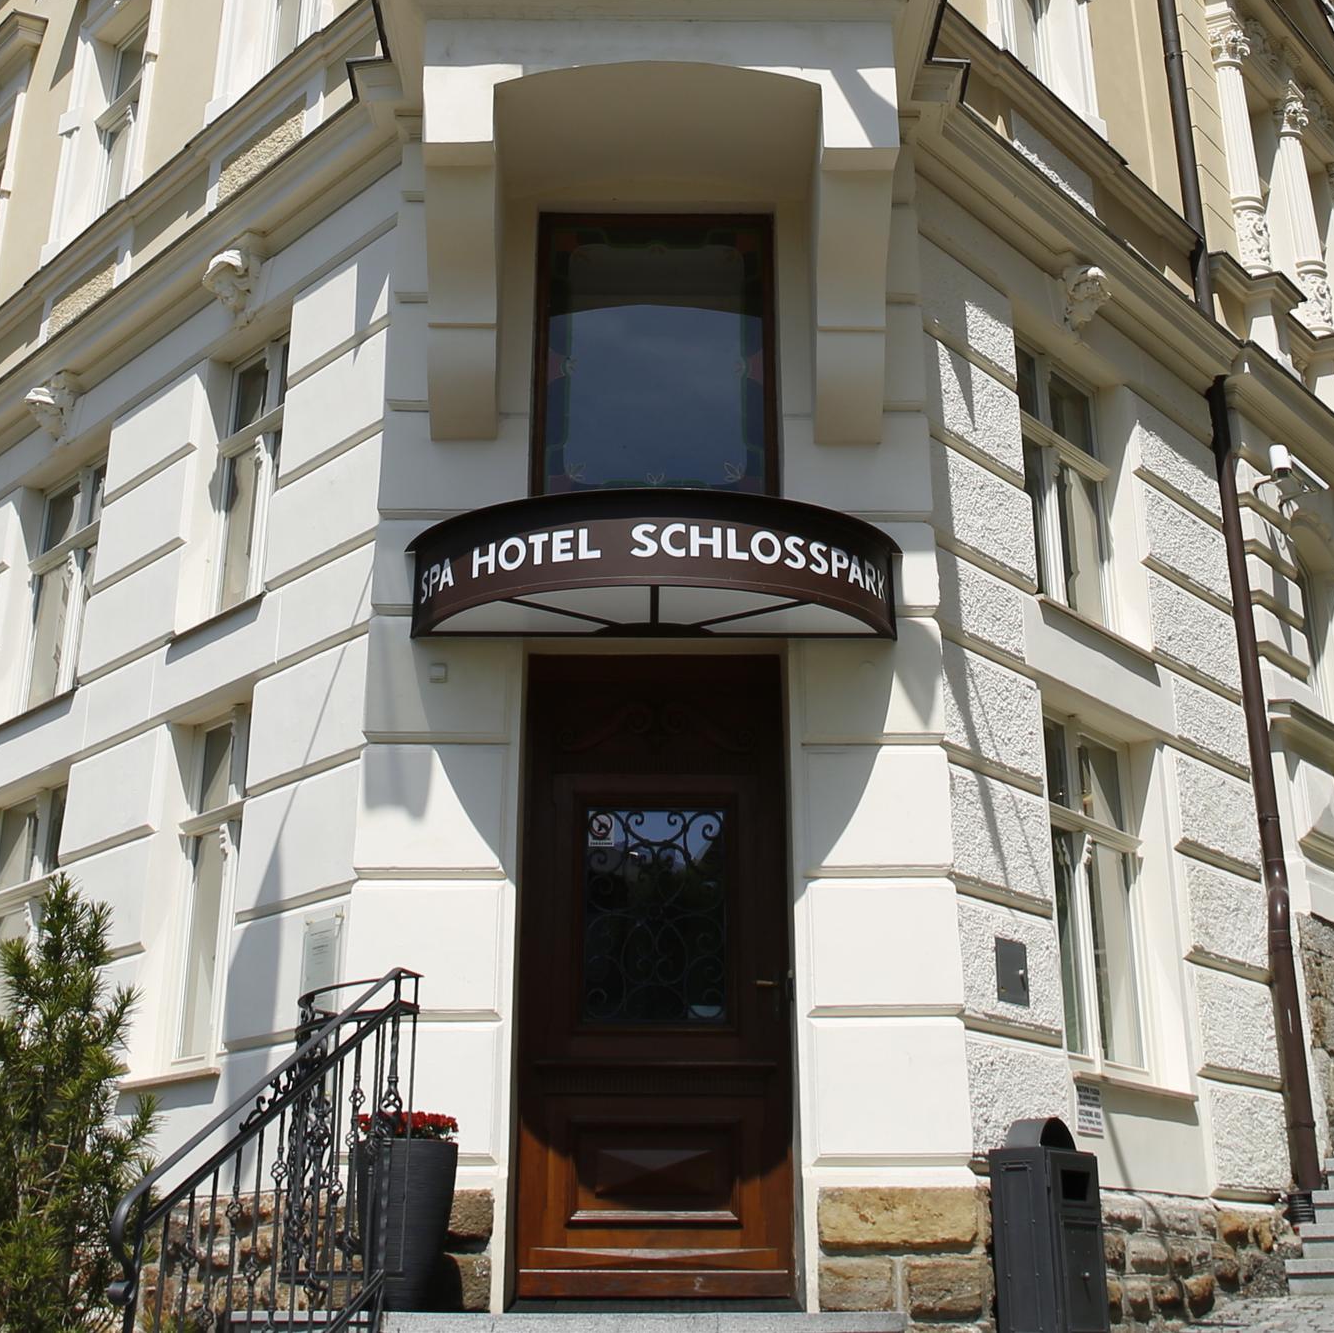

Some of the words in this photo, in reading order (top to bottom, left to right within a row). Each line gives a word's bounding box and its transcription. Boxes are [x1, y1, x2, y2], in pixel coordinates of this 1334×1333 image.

[420, 557, 455, 604] SPA
[471, 528, 602, 579] HOTEL
[630, 522, 887, 604] SCHLOSSPARK
